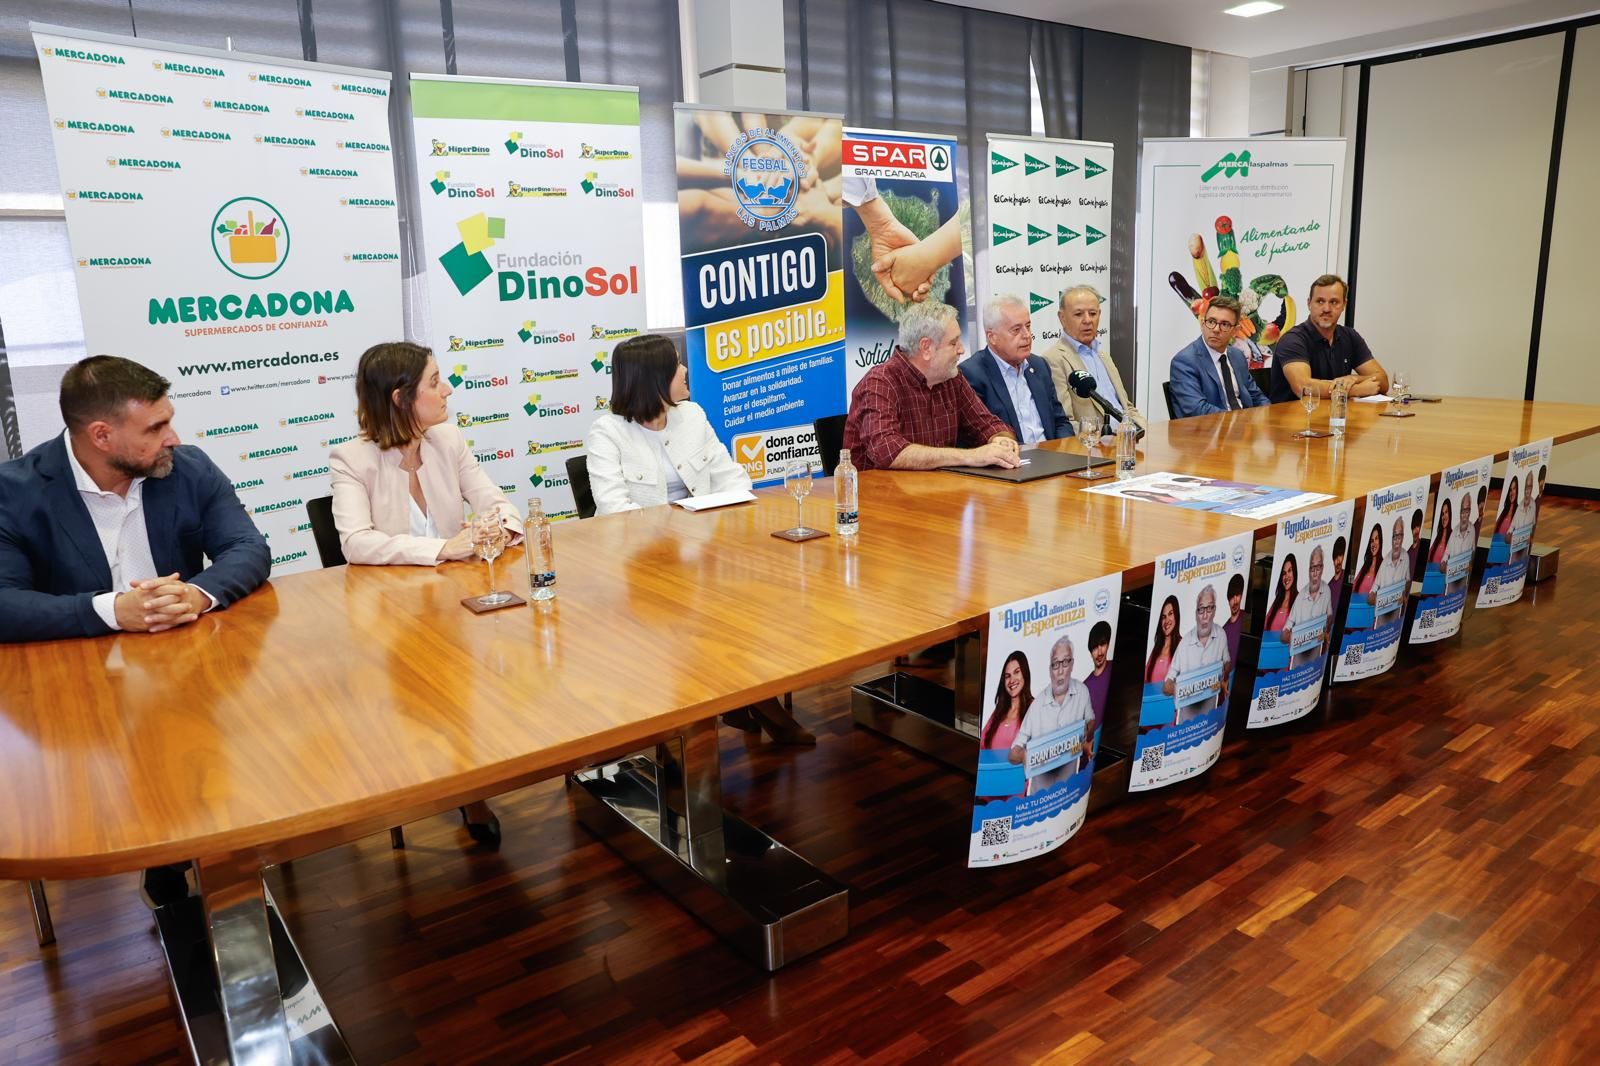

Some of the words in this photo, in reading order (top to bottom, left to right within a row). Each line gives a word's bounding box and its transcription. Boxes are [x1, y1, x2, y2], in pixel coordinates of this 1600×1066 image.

[55, 48, 125, 65] MERCADONA
[164, 63, 225, 77] MERCADONA
[259, 74, 312, 87] MERCADONA
[109, 89, 174, 104] MERCADONA
[341, 84, 387, 96] MERCADONA
[214, 100, 270, 113] MERCADONA
[305, 109, 355, 121] MERCADONA
[67, 120, 135, 134] MERCADONA
[172, 128, 231, 141] MERCADONA
[264, 136, 316, 147] MERCADONA
[345, 142, 390, 151] MERCADONA
[448, 146, 490, 154] HiperDino
[520, 148, 564, 159] DinoSol
[723, 132, 748, 176] BANCOS
[748, 127, 762, 138] DE
[764, 128, 807, 178] ALIMENTOS
[852, 144, 925, 165] SPAR
[119, 158, 181, 169] MERCADONA
[742, 158, 788, 171] FESBAL
[309, 168, 358, 177] MERCADONA
[854, 168, 882, 176] GRAN
[884, 169, 927, 179] CANARIA
[79, 191, 144, 201] MERCADONA
[448, 188, 495, 198] DinoSol
[595, 188, 634, 198] DinoSol
[349, 199, 395, 207] MERCADONA
[736, 207, 756, 228] LAS
[759, 207, 799, 232] PALMAS
[1240, 219, 1321, 244] Alimentando
[352, 253, 399, 261] MERCADONA
[497, 251, 582, 269] Fundación
[1255, 242, 1268, 258] el
[1268, 241, 1310, 265] futuro
[89, 257, 152, 267] MERCADONA
[498, 266, 638, 301] DinoSol
[699, 246, 816, 310] CONTIGO
[148, 289, 355, 325] MERCADONA
[184, 324, 263, 337] SUPERMERCADOS
[265, 323, 276, 331] DE
[278, 319, 329, 330] CONFIANZA
[604, 327, 638, 336] SuperDino
[715, 329, 742, 361] es
[747, 308, 844, 359] posible...
[465, 337, 504, 347] HiperDino
[533, 332, 576, 345] DinoSol
[855, 339, 895, 368] Solid
[177, 351, 339, 377] www.mercadona.es
[722, 379, 742, 392] Donar
[743, 371, 775, 386] alimentos
[781, 364, 799, 376] miles
[799, 361, 808, 370] de
[808, 355, 834, 369] familias.
[230, 378, 311, 393] www.twitter.com/mercadona
[465, 376, 509, 390] DinoSol
[723, 390, 749, 404] Avanzar
[750, 388, 759, 396] en
[760, 385, 767, 394] la
[768, 375, 803, 392] solidaridad.
[538, 404, 580, 418] DinoSol
[723, 404, 743, 416] Evitar
[743, 402, 750, 410] el
[751, 392, 787, 409] despilfarro.
[288, 412, 335, 425] MERCADONA
[472, 411, 510, 423] HiperDino
[724, 416, 746, 428] Cuidar
[746, 413, 753, 422] el
[754, 407, 775, 420] medio
[775, 399, 805, 414] ambiente
[206, 423, 259, 437] MERCADONA
[766, 436, 795, 449] dona
[796, 432, 817, 444] con
[248, 445, 298, 459] MERCADONA
[766, 445, 821, 463] confianza
[293, 466, 329, 479] MERCADO
[254, 499, 303, 514] MERCADONA
[1284, 516, 1310, 539] Ayuda
[1164, 552, 1197, 579] Ayuda
[1177, 561, 1226, 584] Esperanza
[1004, 601, 1048, 632] Ayuda
[1049, 600, 1078, 615] alimenta
[1078, 597, 1085, 609] la
[1023, 607, 1086, 637] Esperanza
[1030, 751, 1049, 765] GRAN
[1015, 802, 1030, 812] HAZ
[1030, 798, 1039, 808] TU
[1039, 786, 1068, 805] DONACIÓN
